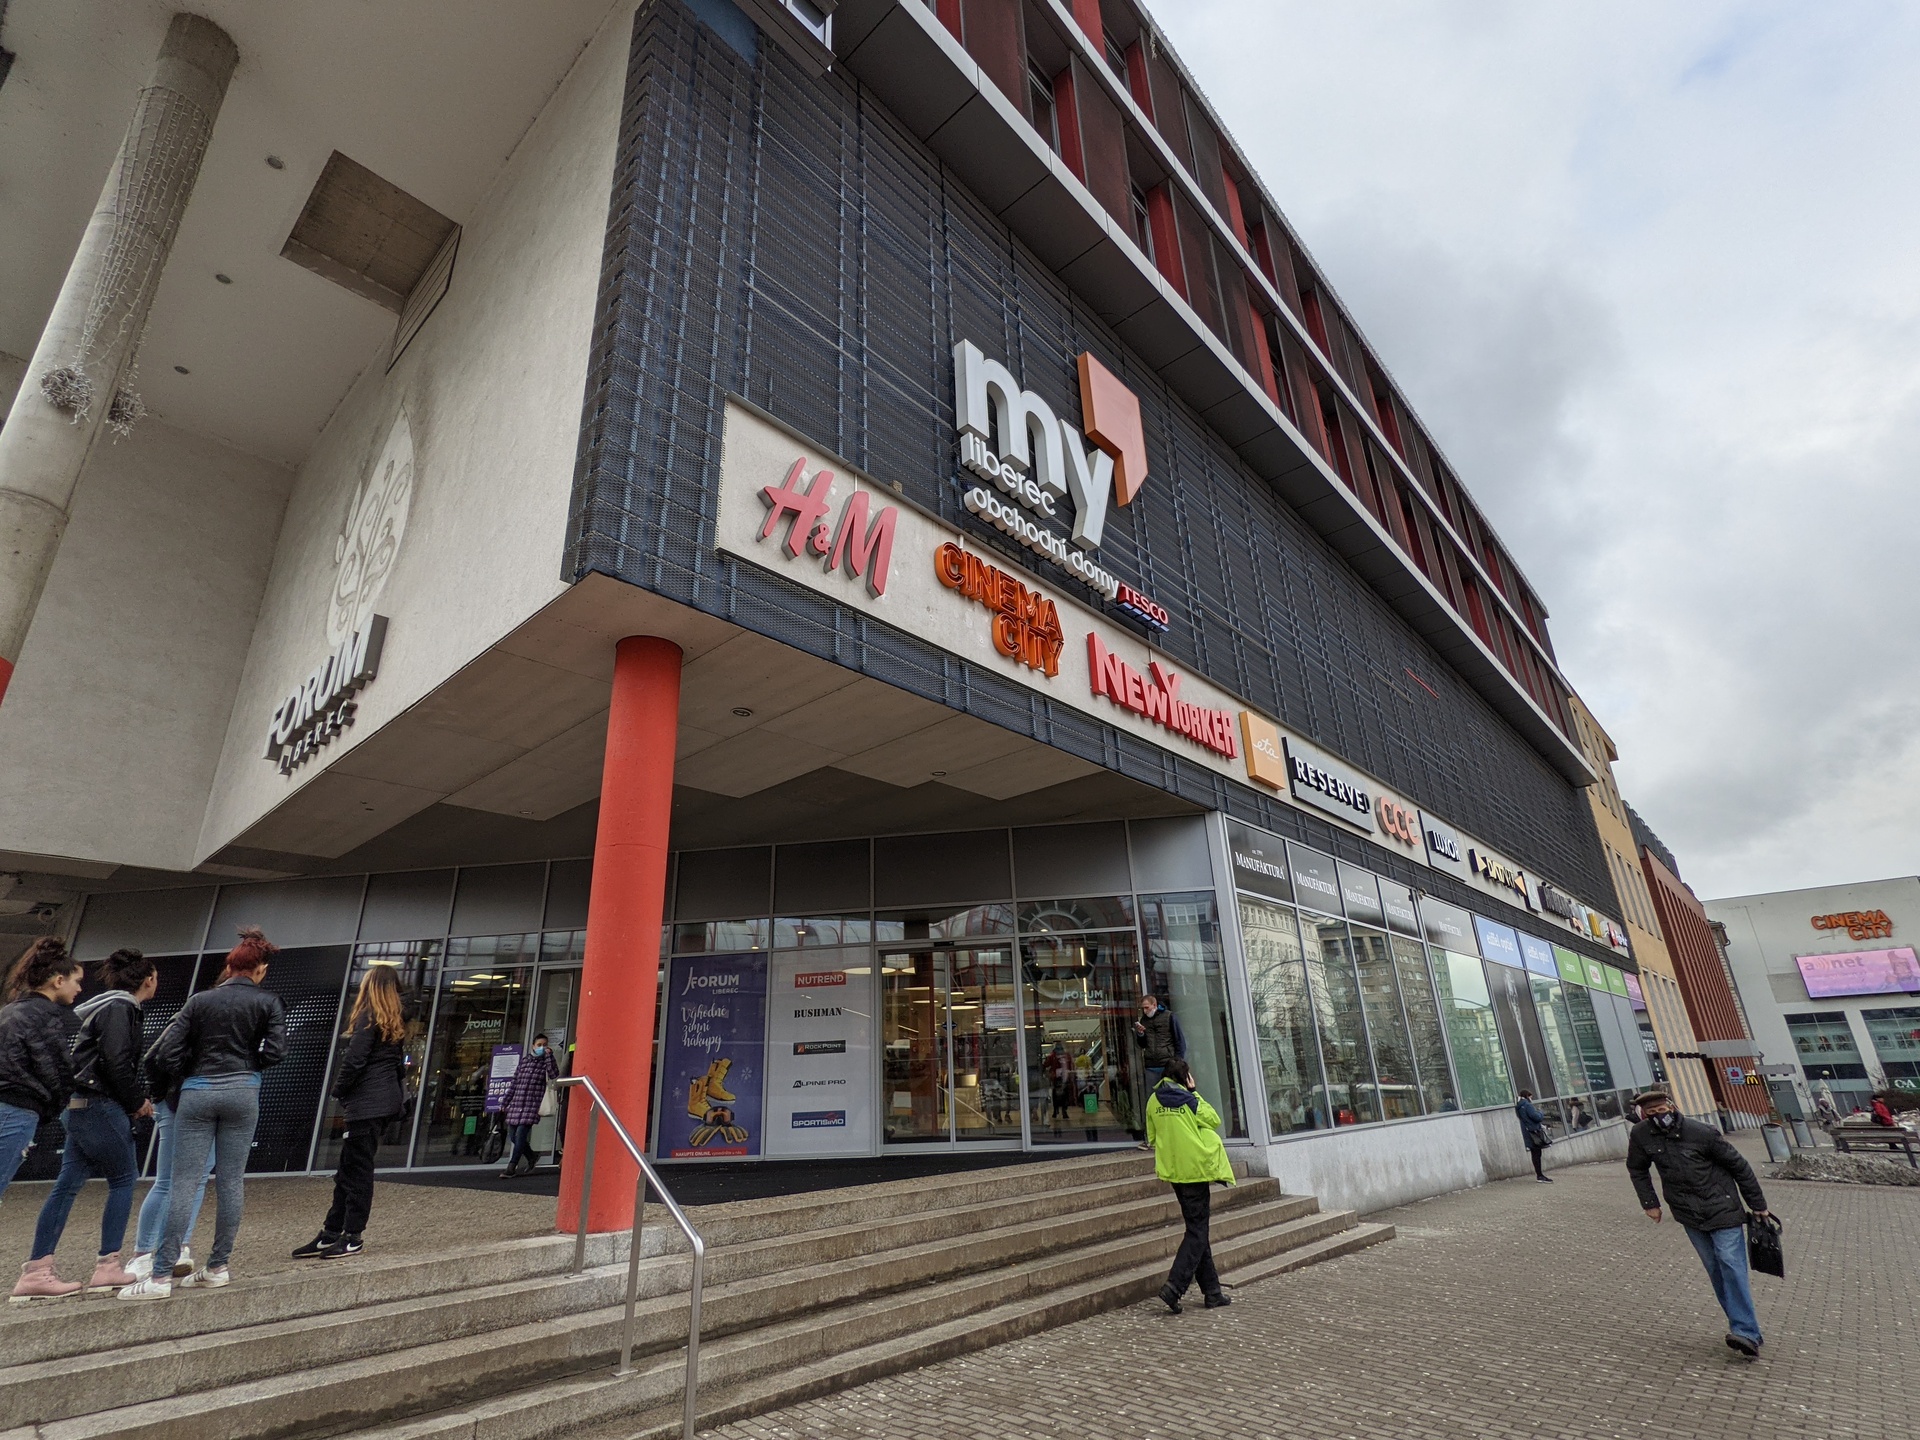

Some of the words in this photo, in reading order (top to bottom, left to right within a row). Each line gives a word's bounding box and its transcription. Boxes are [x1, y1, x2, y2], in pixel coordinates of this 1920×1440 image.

[954, 339, 1115, 550] my
[961, 432, 1056, 518] liberec
[756, 457, 897, 599] H&M
[964, 487, 1067, 565] obchodní
[1065, 551, 1120, 601] domy
[934, 541, 1064, 628] CINEMA
[1123, 584, 1169, 624] TESCO
[992, 611, 1064, 677] CITY
[262, 613, 388, 762] FORUM
[278, 698, 359, 777] LIBEREC
[1252, 738, 1280, 760] eta
[1291, 756, 1371, 814] RESERVED
[1376, 796, 1419, 846] CCC
[1430, 830, 1461, 862] LUXOR
[1234, 851, 1286, 880] MANUFAKTURA
[1295, 871, 1337, 896] MANUFAKTURA
[1811, 909, 1892, 930] CINEMA
[1848, 924, 1892, 941] CITY
[689, 973, 740, 990] FORUM
[712, 986, 739, 995] LIBEREC
[797, 974, 844, 985] NUTREND
[468, 1019, 502, 1030] FORUM
[794, 1007, 842, 1018] BUSHMAN
[792, 1079, 827, 1088] ALPINE
